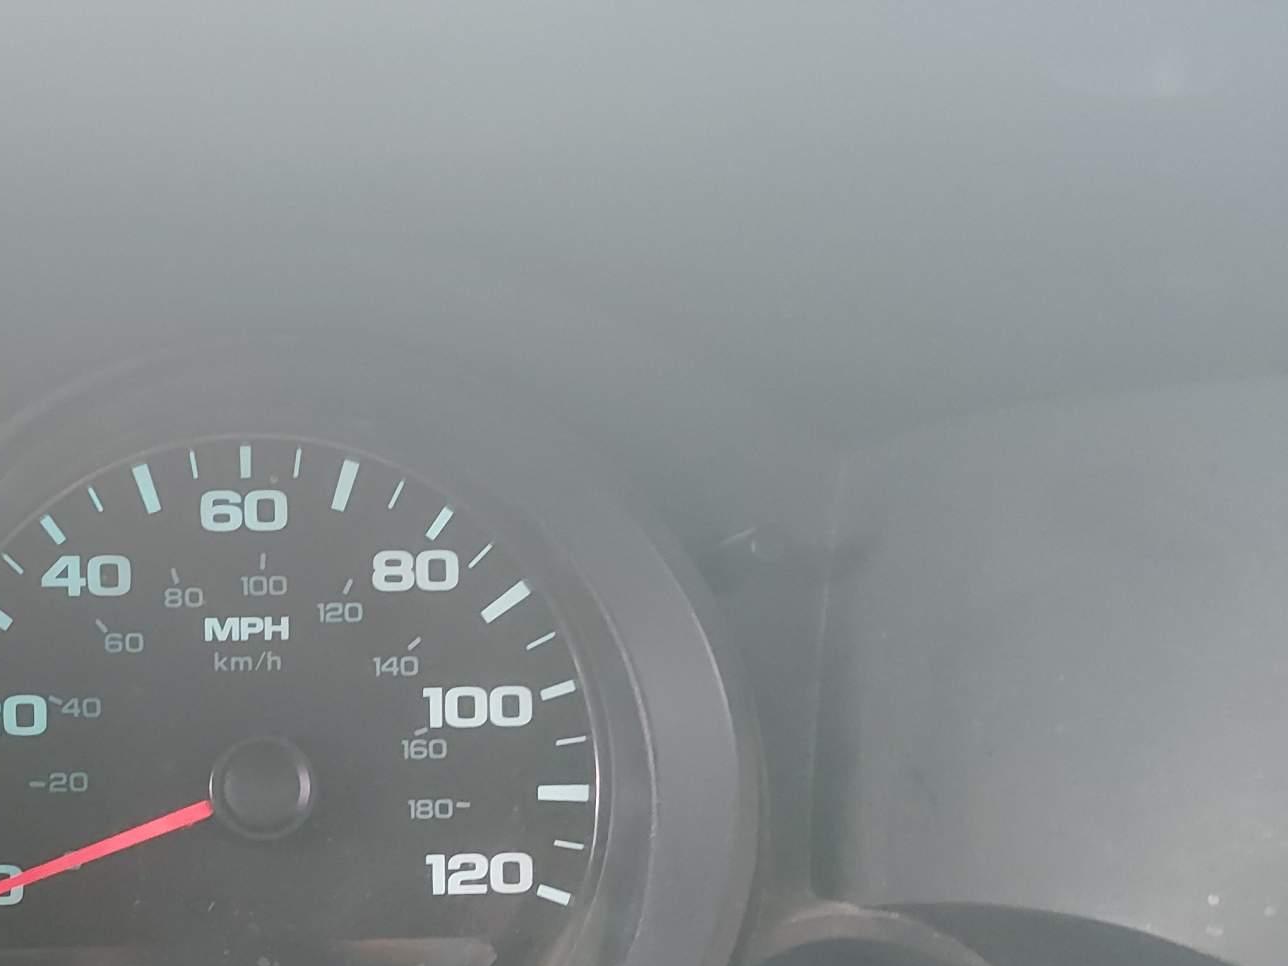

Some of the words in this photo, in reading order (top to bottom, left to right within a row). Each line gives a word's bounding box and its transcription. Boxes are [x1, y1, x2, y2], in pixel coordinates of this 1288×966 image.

[200, 490, 288, 532] 60
[40, 555, 132, 597] 40
[372, 549, 460, 592] 80
[240, 575, 288, 597] 100
[163, 587, 204, 609] 80
[317, 602, 363, 624] 120
[203, 616, 290, 642] MPH
[104, 633, 144, 655] 60
[213, 651, 282, 673] km/h
[373, 655, 420, 678] 140
[61, 697, 102, 719] 40
[422, 686, 534, 728] 100
[401, 739, 448, 762] 160
[47, 771, 89, 793] 20
[408, 798, 454, 821] 180
[425, 853, 534, 895] 120
